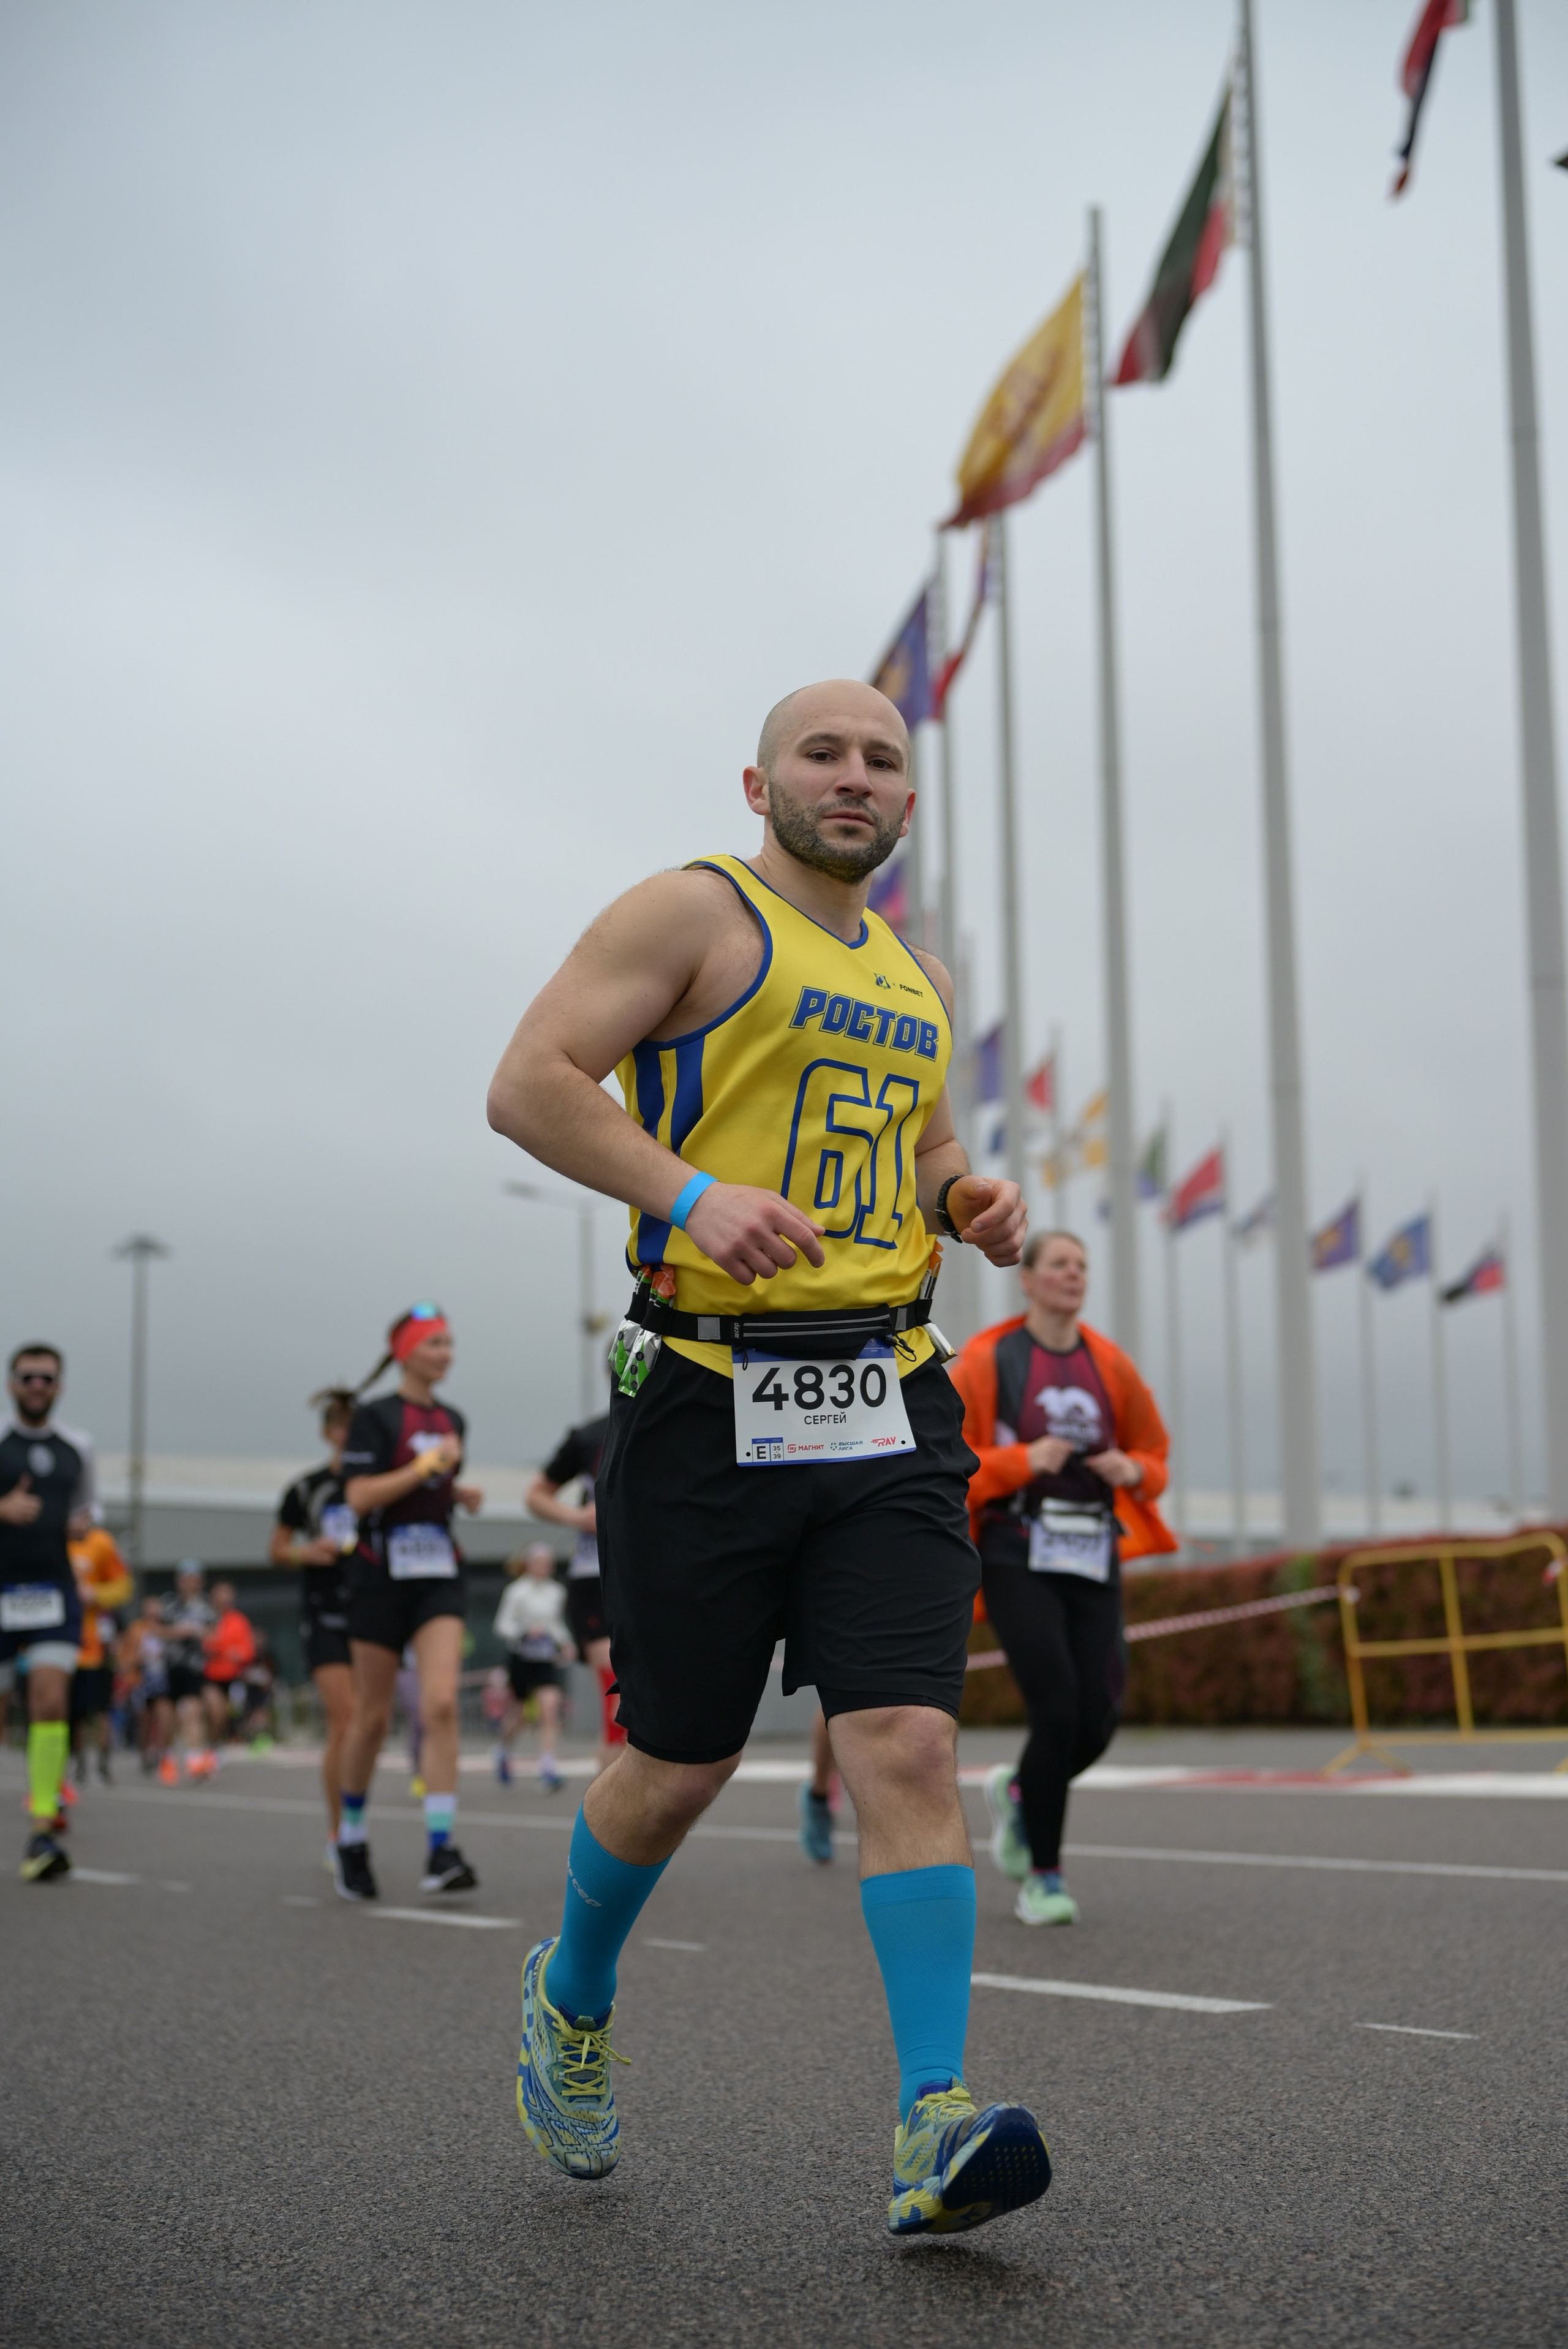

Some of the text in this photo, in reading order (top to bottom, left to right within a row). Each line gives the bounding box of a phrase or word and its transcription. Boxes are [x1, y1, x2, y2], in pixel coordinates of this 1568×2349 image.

[899, 984, 923, 997] FONBET
[788, 986, 939, 1062] РОСТОВ
[780, 1058, 919, 1250] 61
[752, 1363, 886, 1411] 4830
[804, 1412, 846, 1425] СЕРГЕЙ
